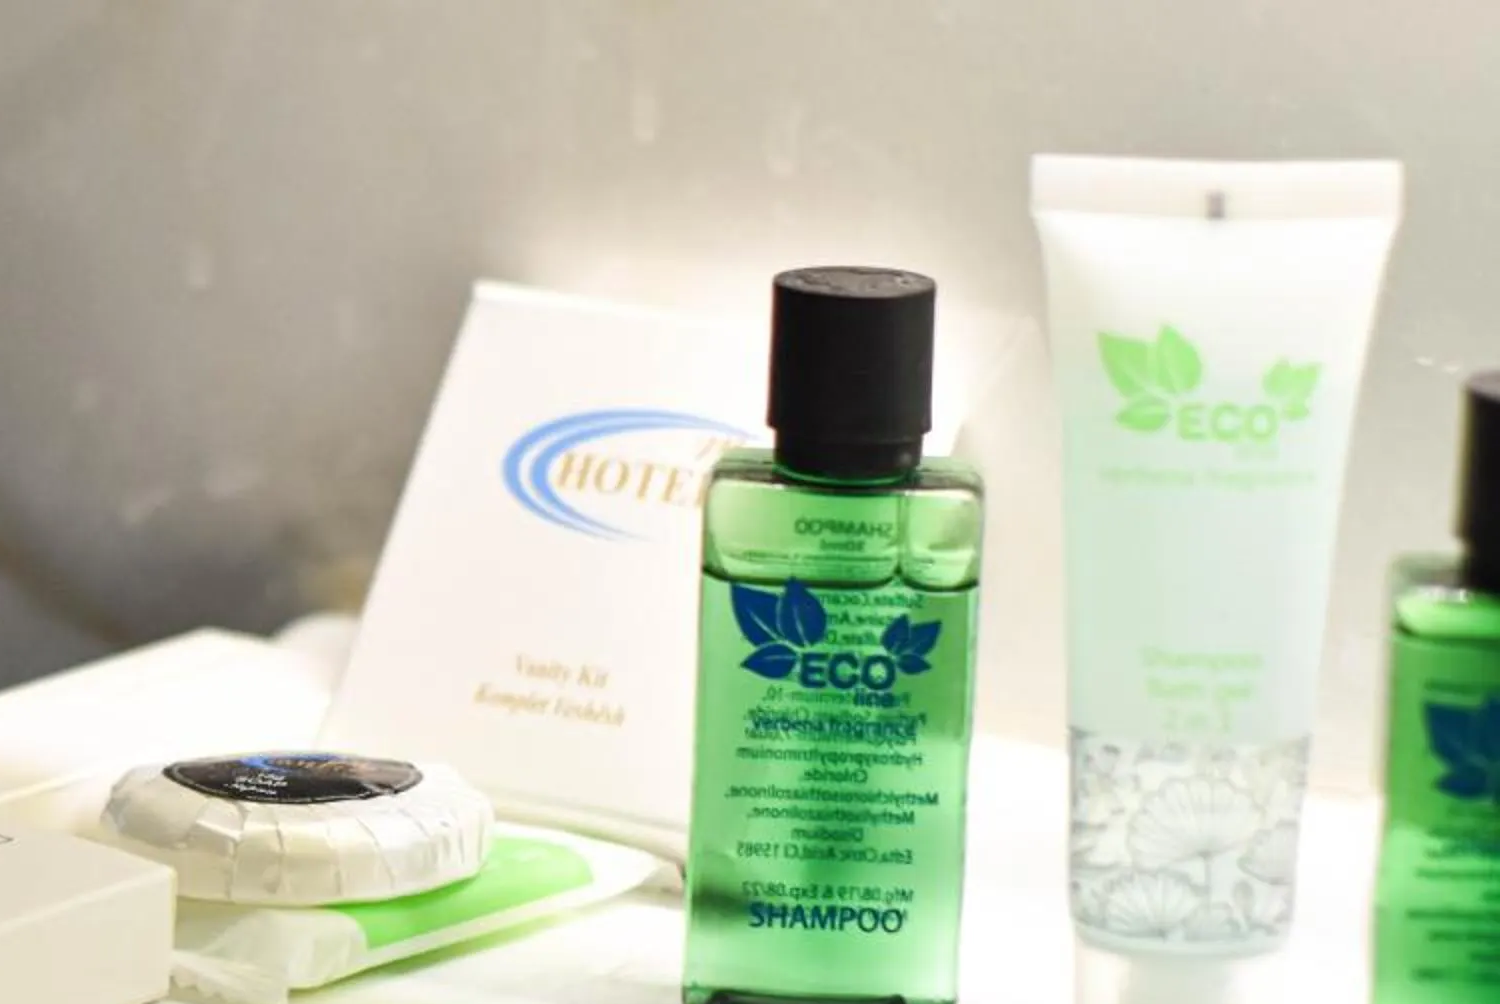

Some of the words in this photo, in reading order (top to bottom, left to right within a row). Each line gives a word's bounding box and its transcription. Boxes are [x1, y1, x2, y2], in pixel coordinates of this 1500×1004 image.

[1176, 403, 1279, 443] ECO
[800, 652, 897, 691] ECO
[852, 688, 896, 709] line
[748, 901, 904, 934] SHAMPOO
